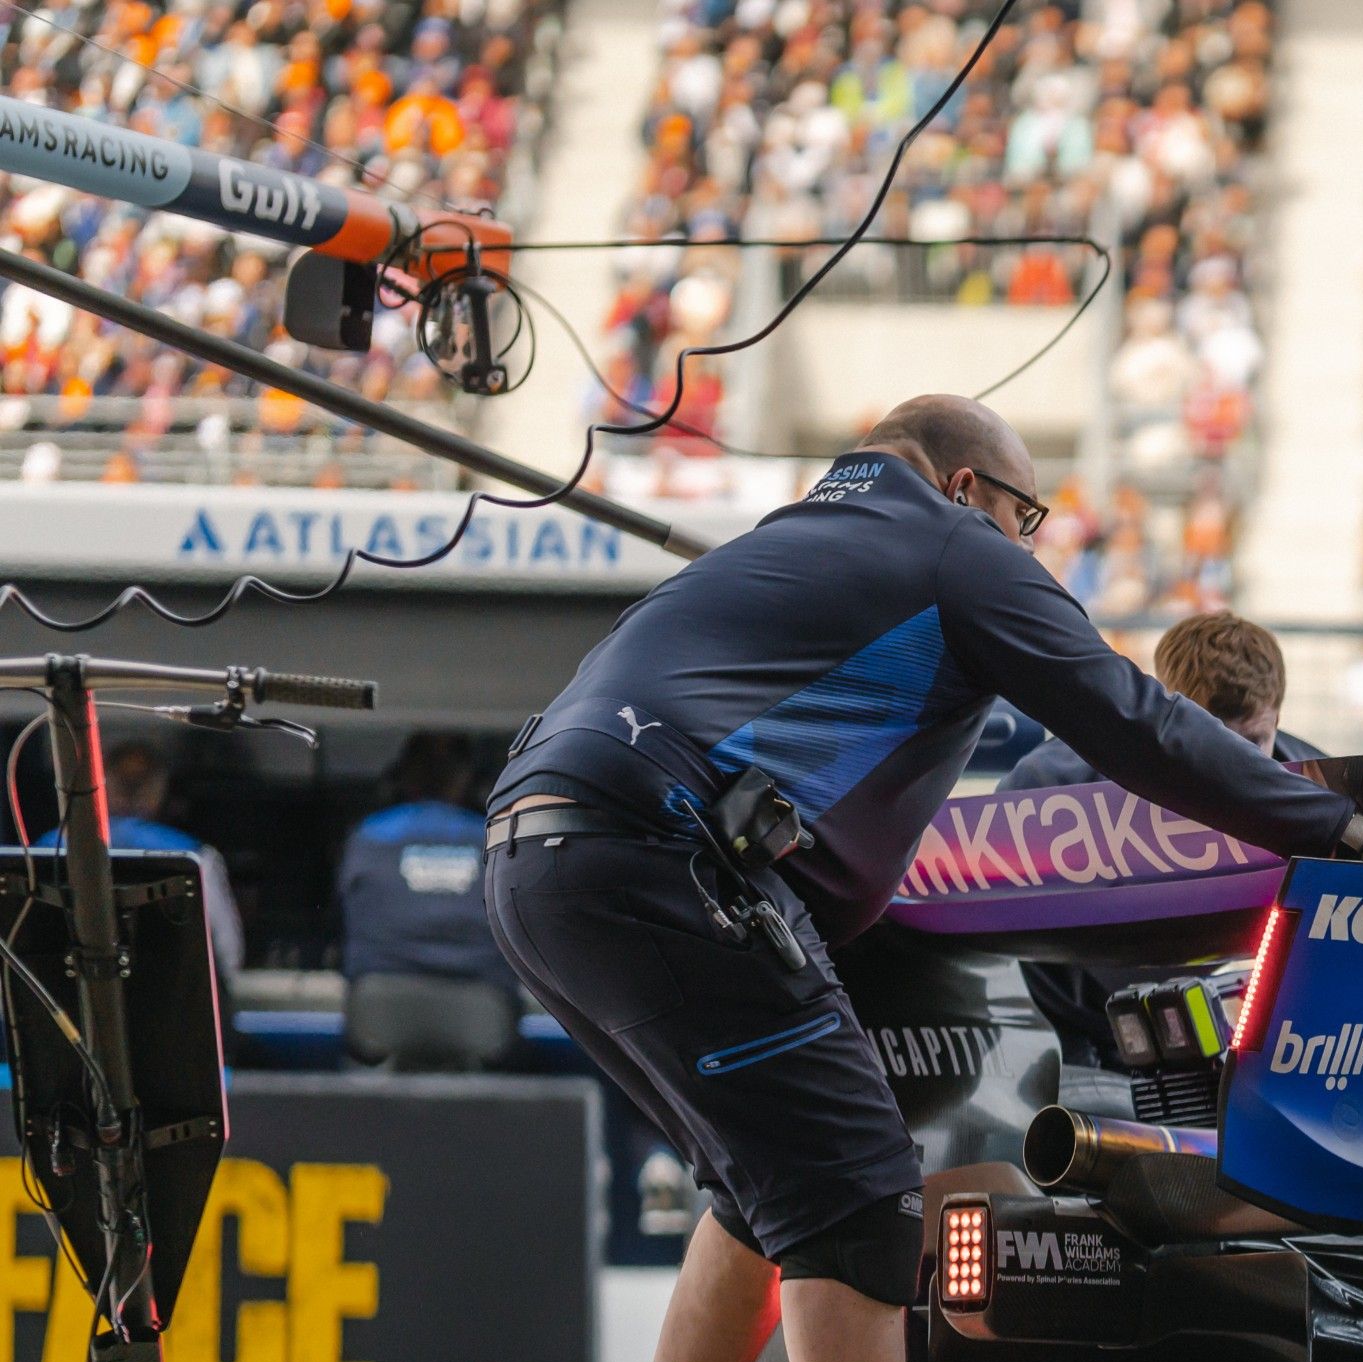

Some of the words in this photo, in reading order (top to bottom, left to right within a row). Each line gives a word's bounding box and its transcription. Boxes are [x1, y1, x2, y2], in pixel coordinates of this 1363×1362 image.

[218, 158, 322, 231] Gulf
[824, 463, 885, 481] SSIAN
[245, 510, 623, 565] ATLASSIAN
[1064, 1233, 1104, 1247] FRANK
[1064, 1246, 1121, 1260] WILLIAMS
[1064, 1259, 1121, 1273] ACADEMY
[997, 1273, 1026, 1283] Powered
[1027, 1275, 1035, 1286] by
[1036, 1274, 1057, 1287] Spinal
[1083, 1277, 1121, 1288] Association
